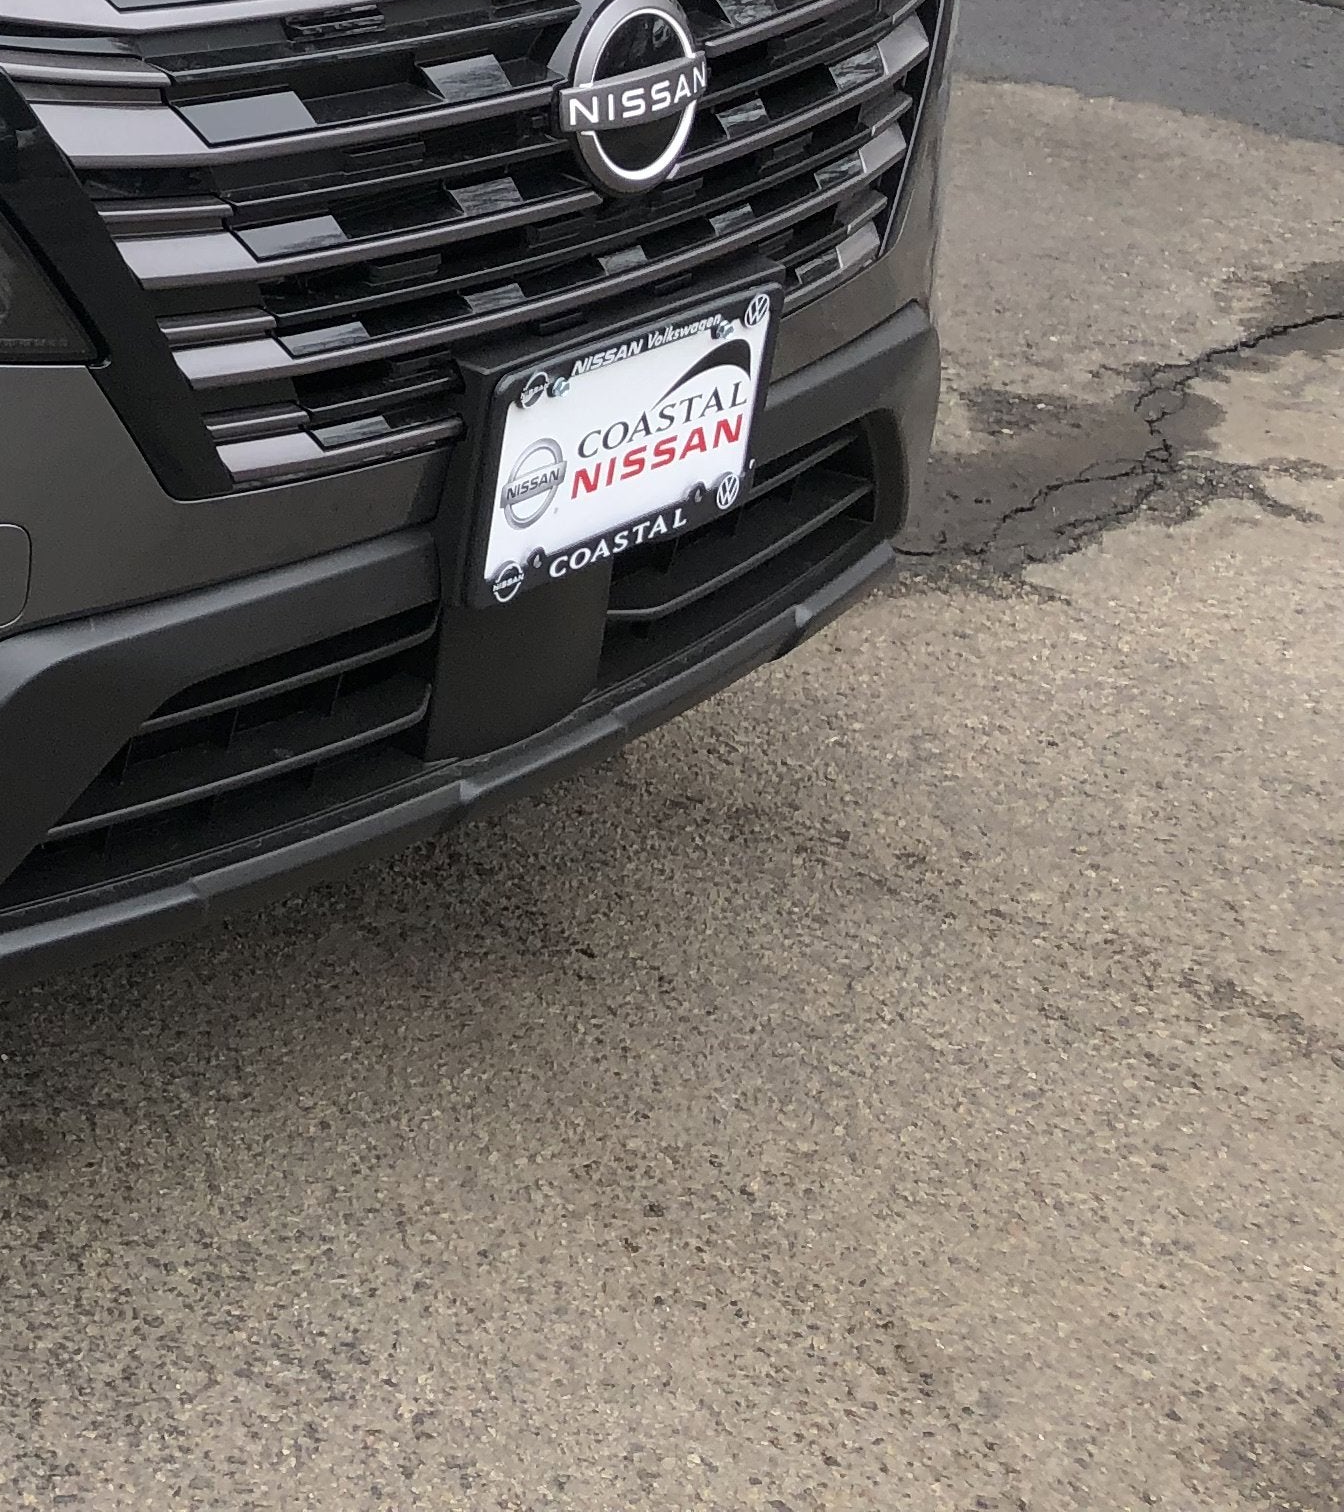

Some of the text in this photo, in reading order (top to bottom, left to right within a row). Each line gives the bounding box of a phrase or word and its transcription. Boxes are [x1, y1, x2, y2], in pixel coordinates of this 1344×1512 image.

[569, 61, 707, 126] NISSAN
[571, 313, 722, 377] NISSAN Volkswagen
[577, 381, 747, 458] COASTAL
[506, 468, 561, 501] NISSAN
[571, 413, 743, 500] NISSAN
[549, 508, 687, 578] COASTAL
